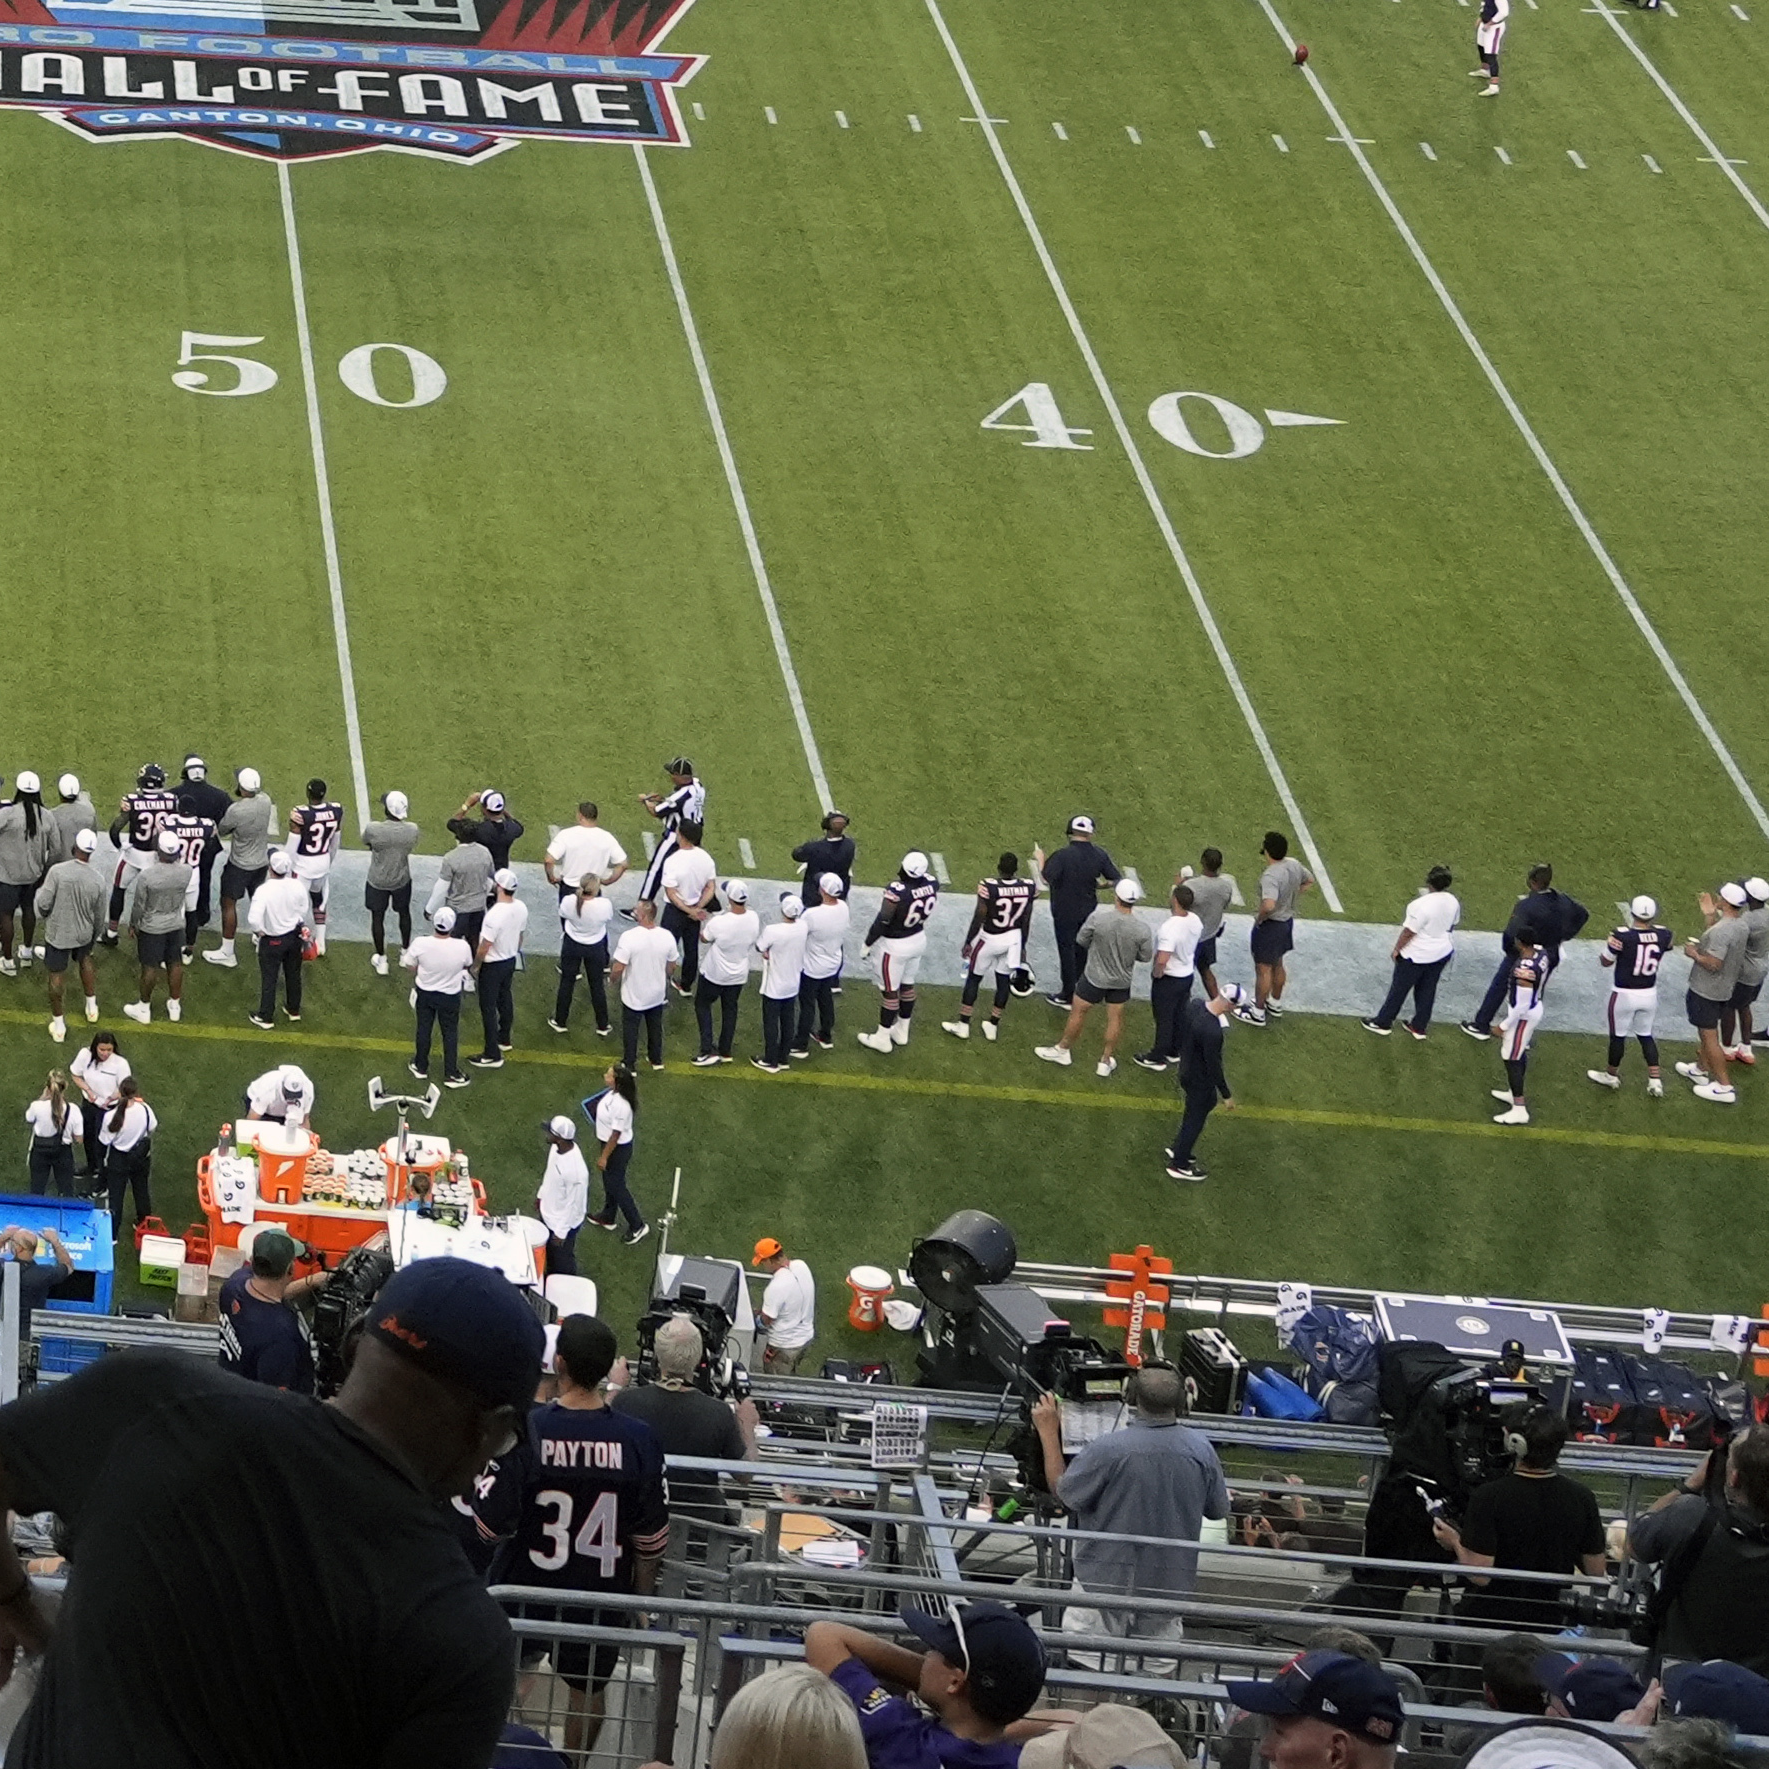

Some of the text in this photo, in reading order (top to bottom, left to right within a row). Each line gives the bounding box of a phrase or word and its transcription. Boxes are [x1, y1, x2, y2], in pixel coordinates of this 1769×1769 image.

[132, 32, 671, 77] FOOTBALL
[237, 66, 309, 93] OF
[316, 68, 640, 126] FAME
[97, 110, 461, 144] CANTON, OHIO
[309, 822, 337, 851] 37
[903, 897, 936, 928] 69
[992, 897, 1029, 927] 37
[1633, 943, 1660, 976] 16
[1126, 1289, 1145, 1368] GATORADE
[540, 1438, 623, 1470] PAYTON
[528, 1489, 623, 1578] 34
